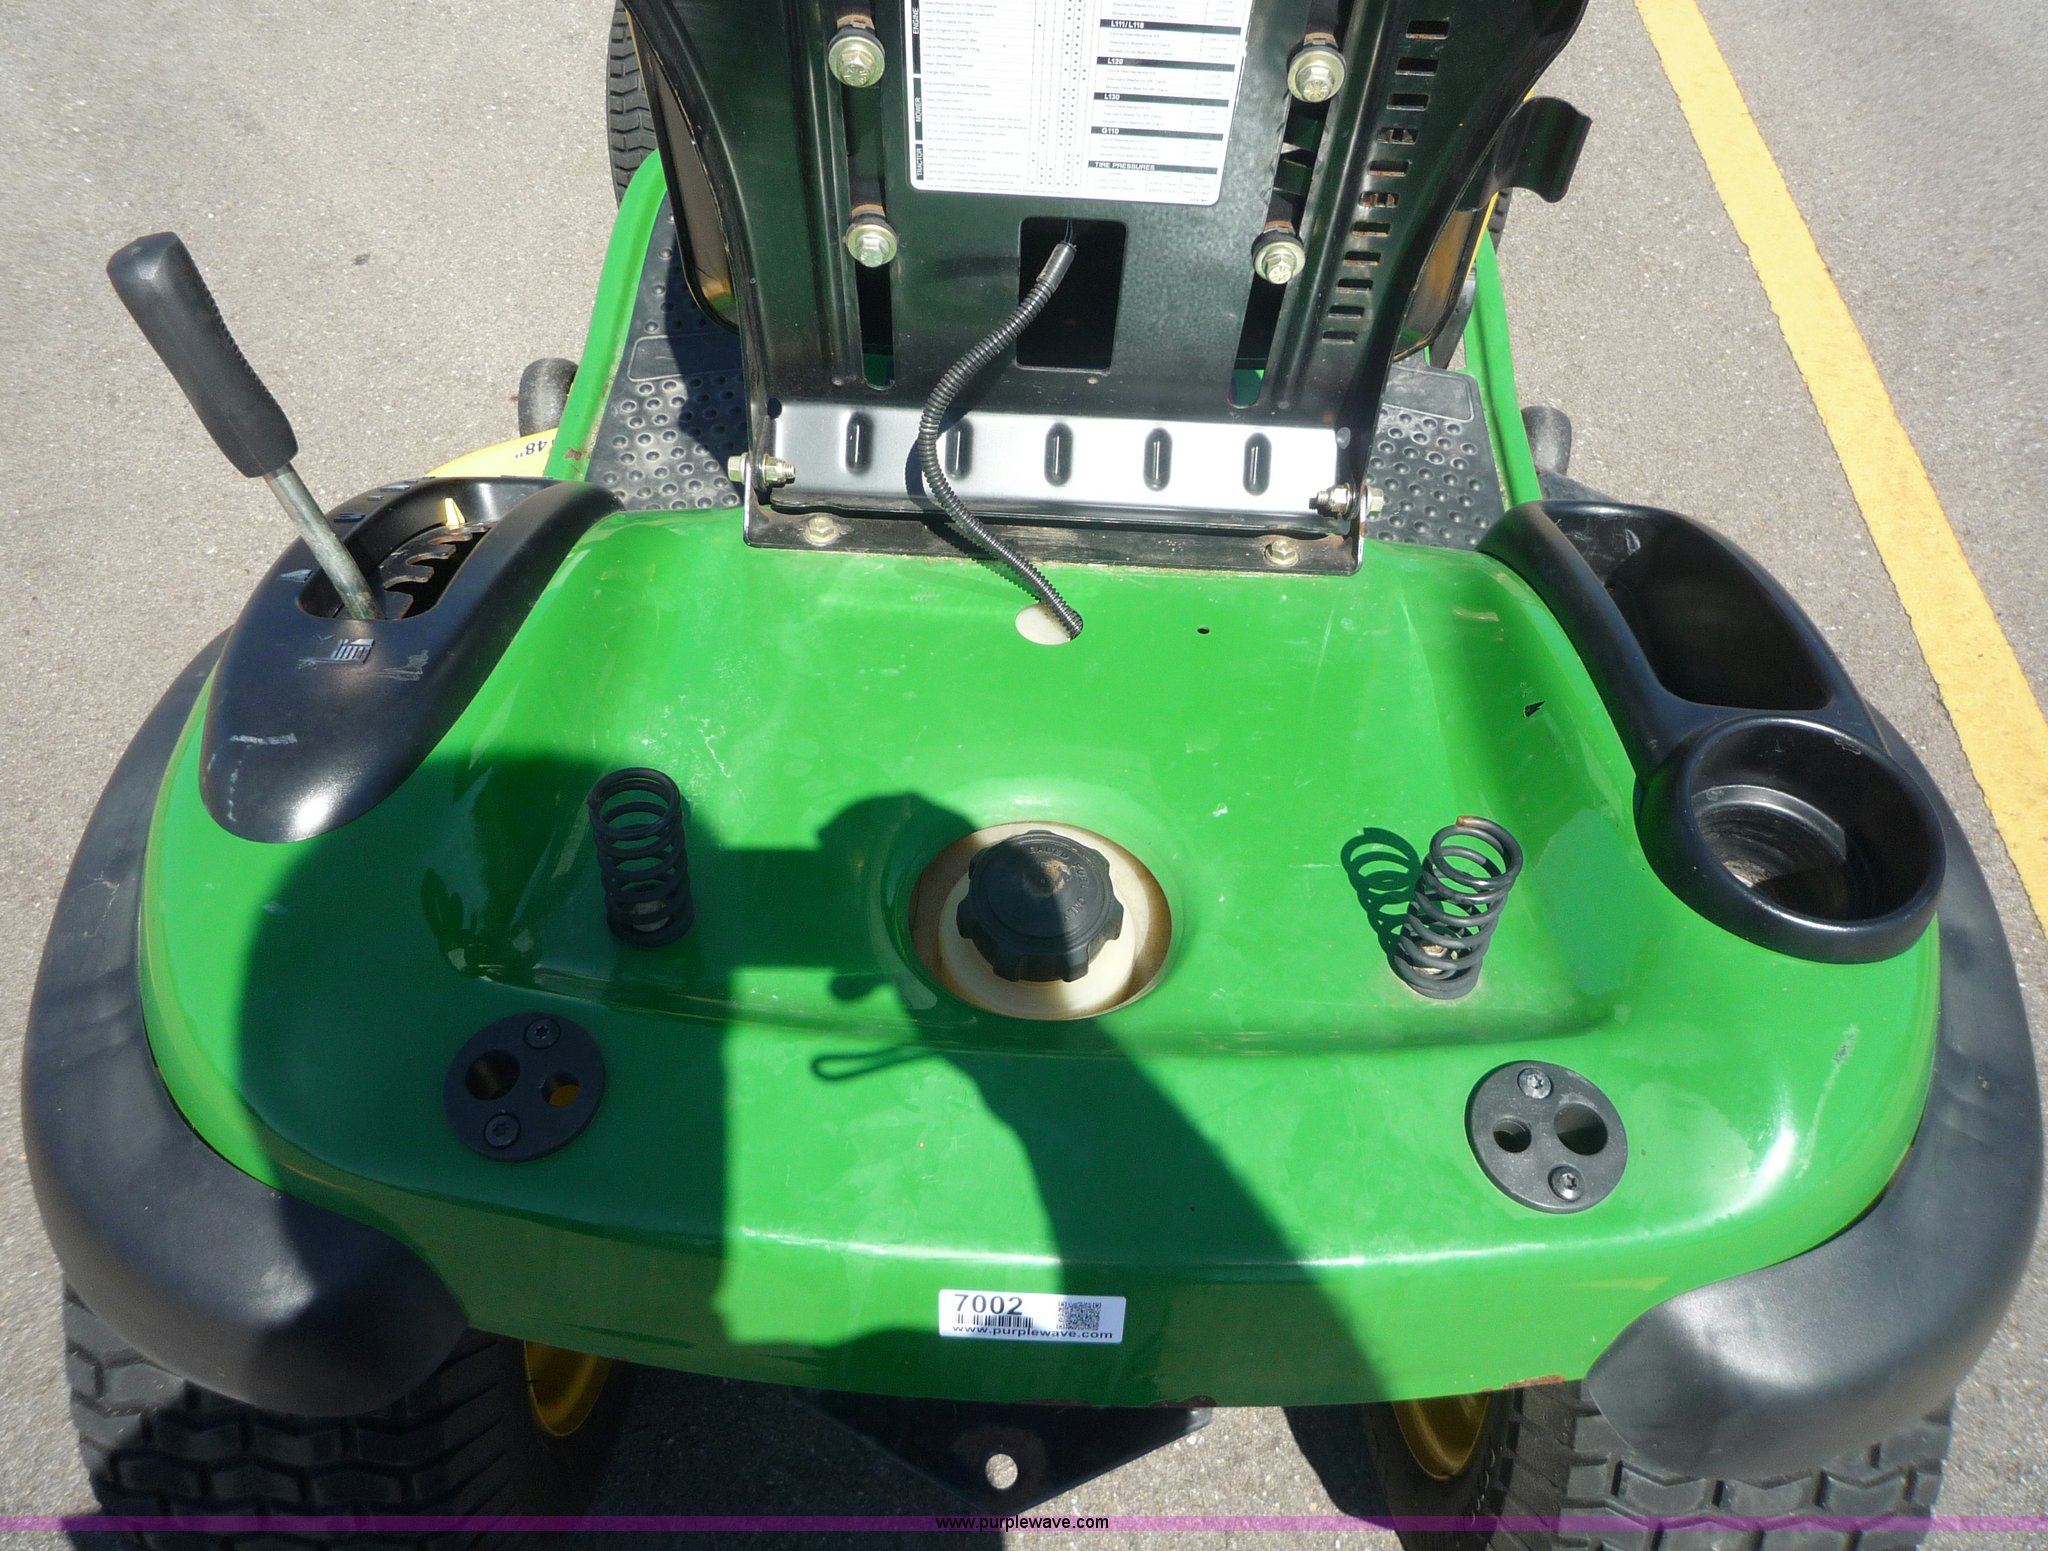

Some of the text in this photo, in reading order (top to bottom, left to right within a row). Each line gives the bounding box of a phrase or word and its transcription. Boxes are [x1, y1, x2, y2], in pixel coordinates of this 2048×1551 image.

[912, 7, 920, 35] ENGINE
[1107, 57, 1124, 65] L120
[914, 97, 922, 123] MOWER
[954, 1293, 1024, 1316] 7002
[952, 1325, 1113, 1340] www.purplewave.com
